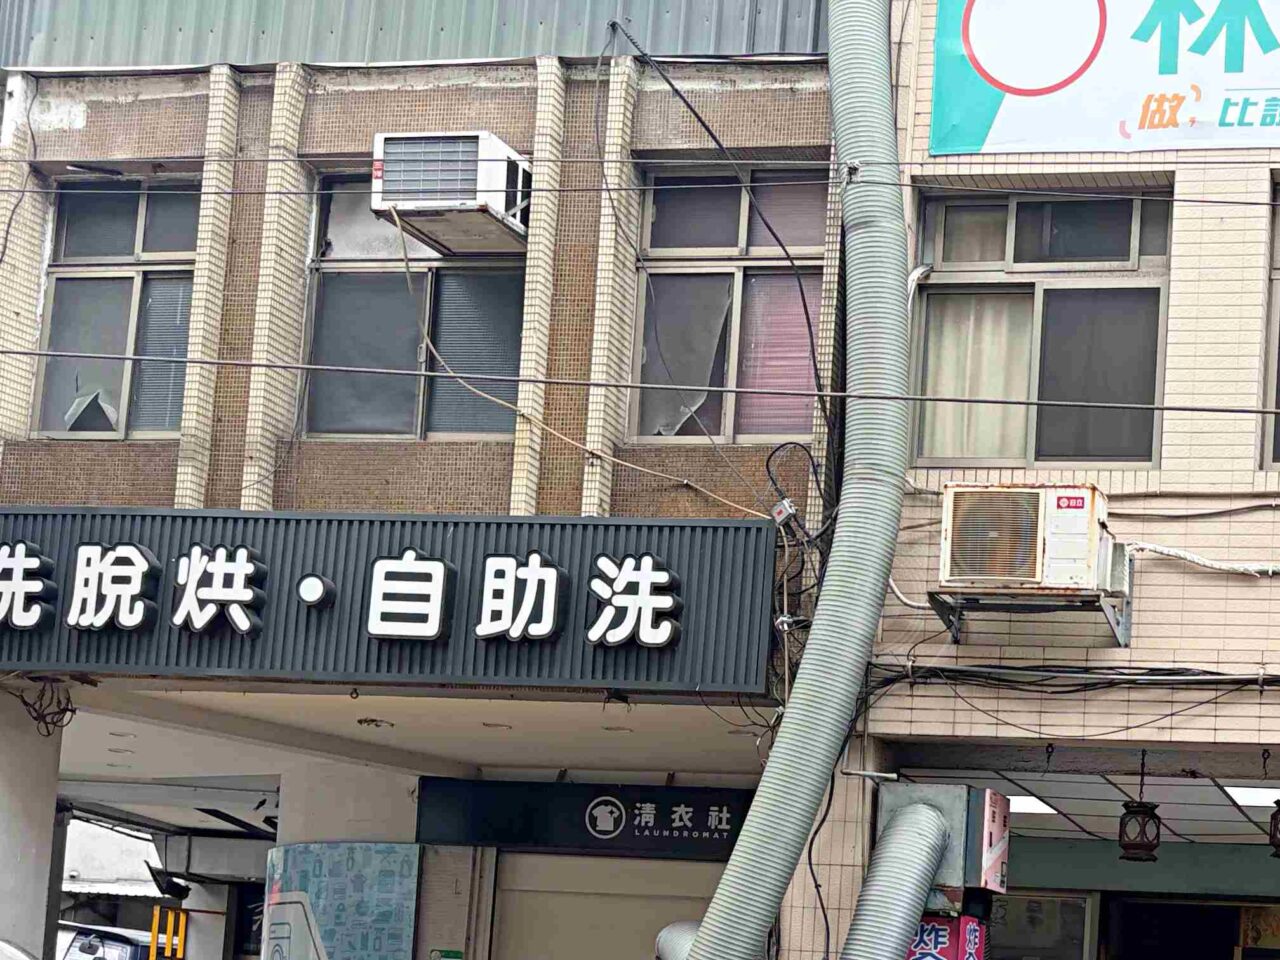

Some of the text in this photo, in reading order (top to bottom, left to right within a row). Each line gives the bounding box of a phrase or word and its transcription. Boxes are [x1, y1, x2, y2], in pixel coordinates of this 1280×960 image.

[633, 802, 731, 830] 清衣社
[634, 828, 730, 839] LAUNDROMAT
